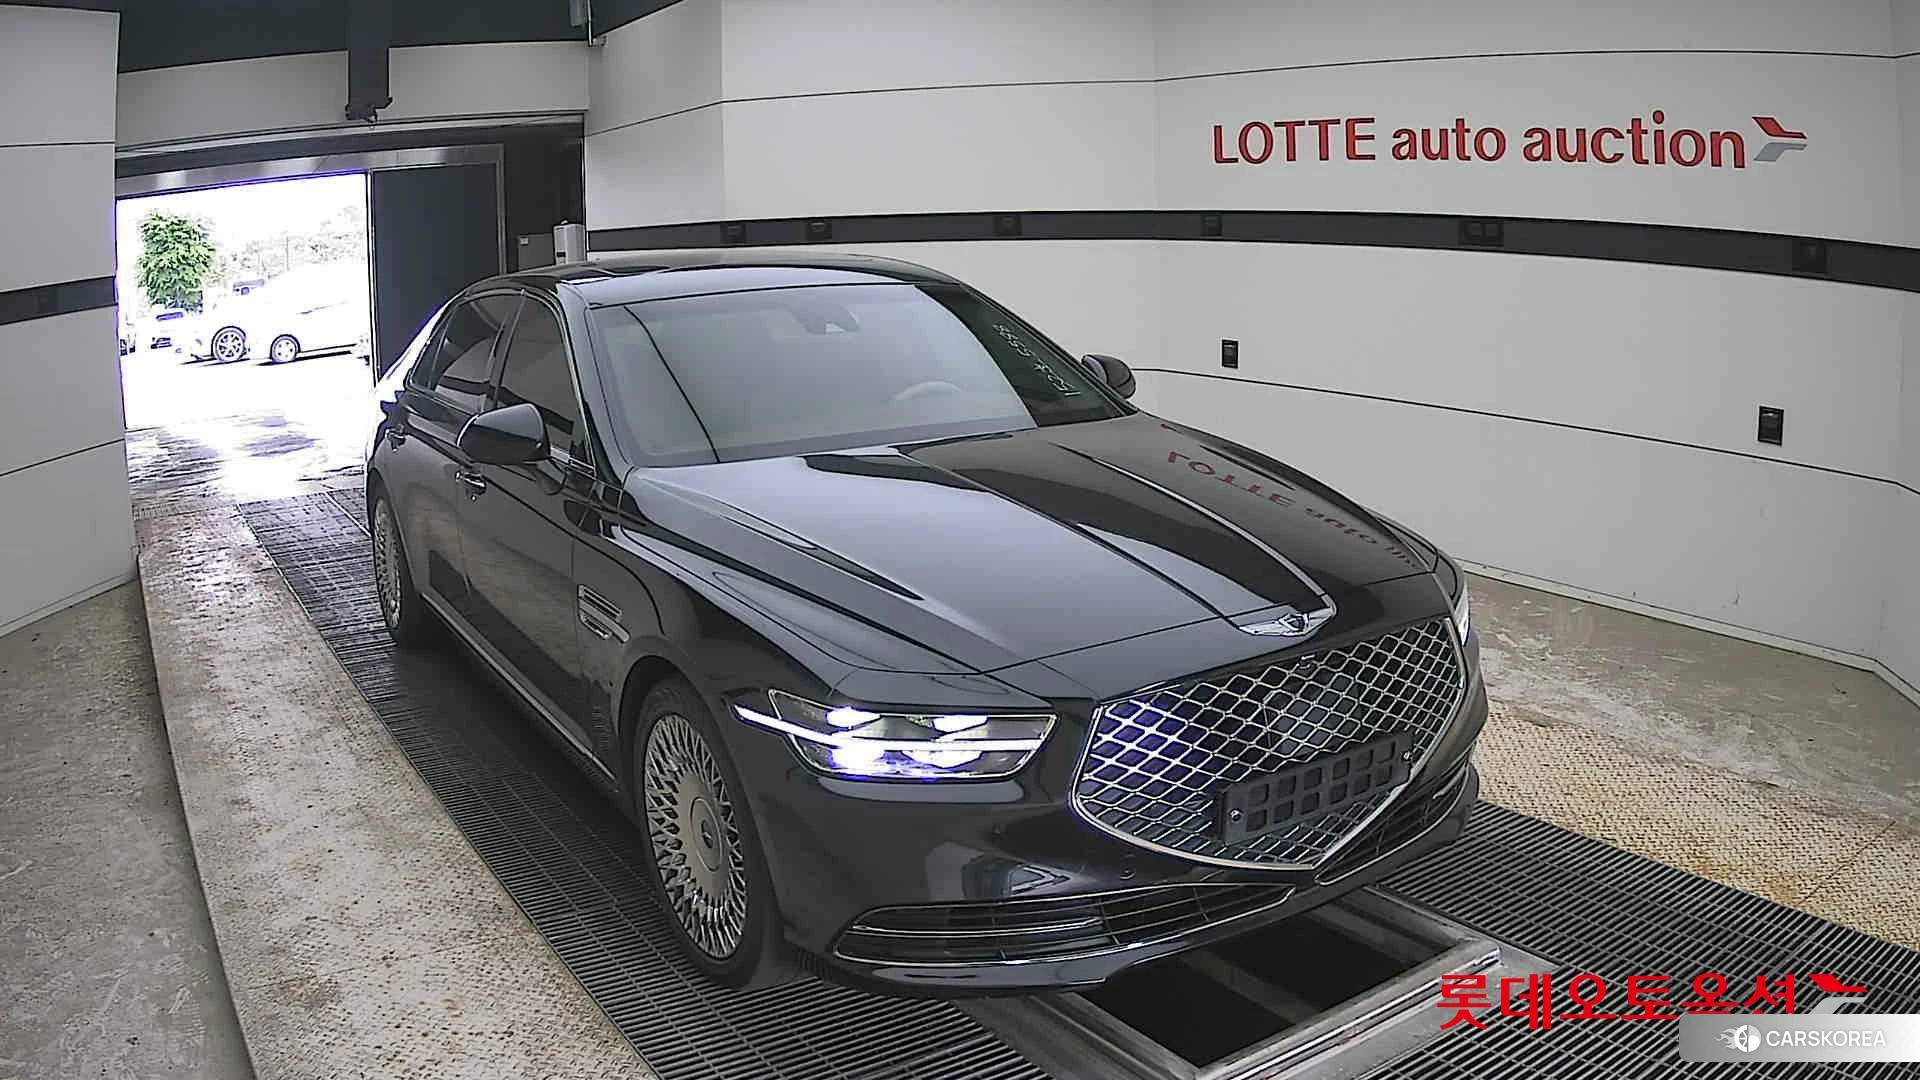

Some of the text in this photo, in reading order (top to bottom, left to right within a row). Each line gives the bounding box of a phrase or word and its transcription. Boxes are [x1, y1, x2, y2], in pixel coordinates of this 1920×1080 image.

[1213, 110, 1746, 169] LOTTE auto auction
